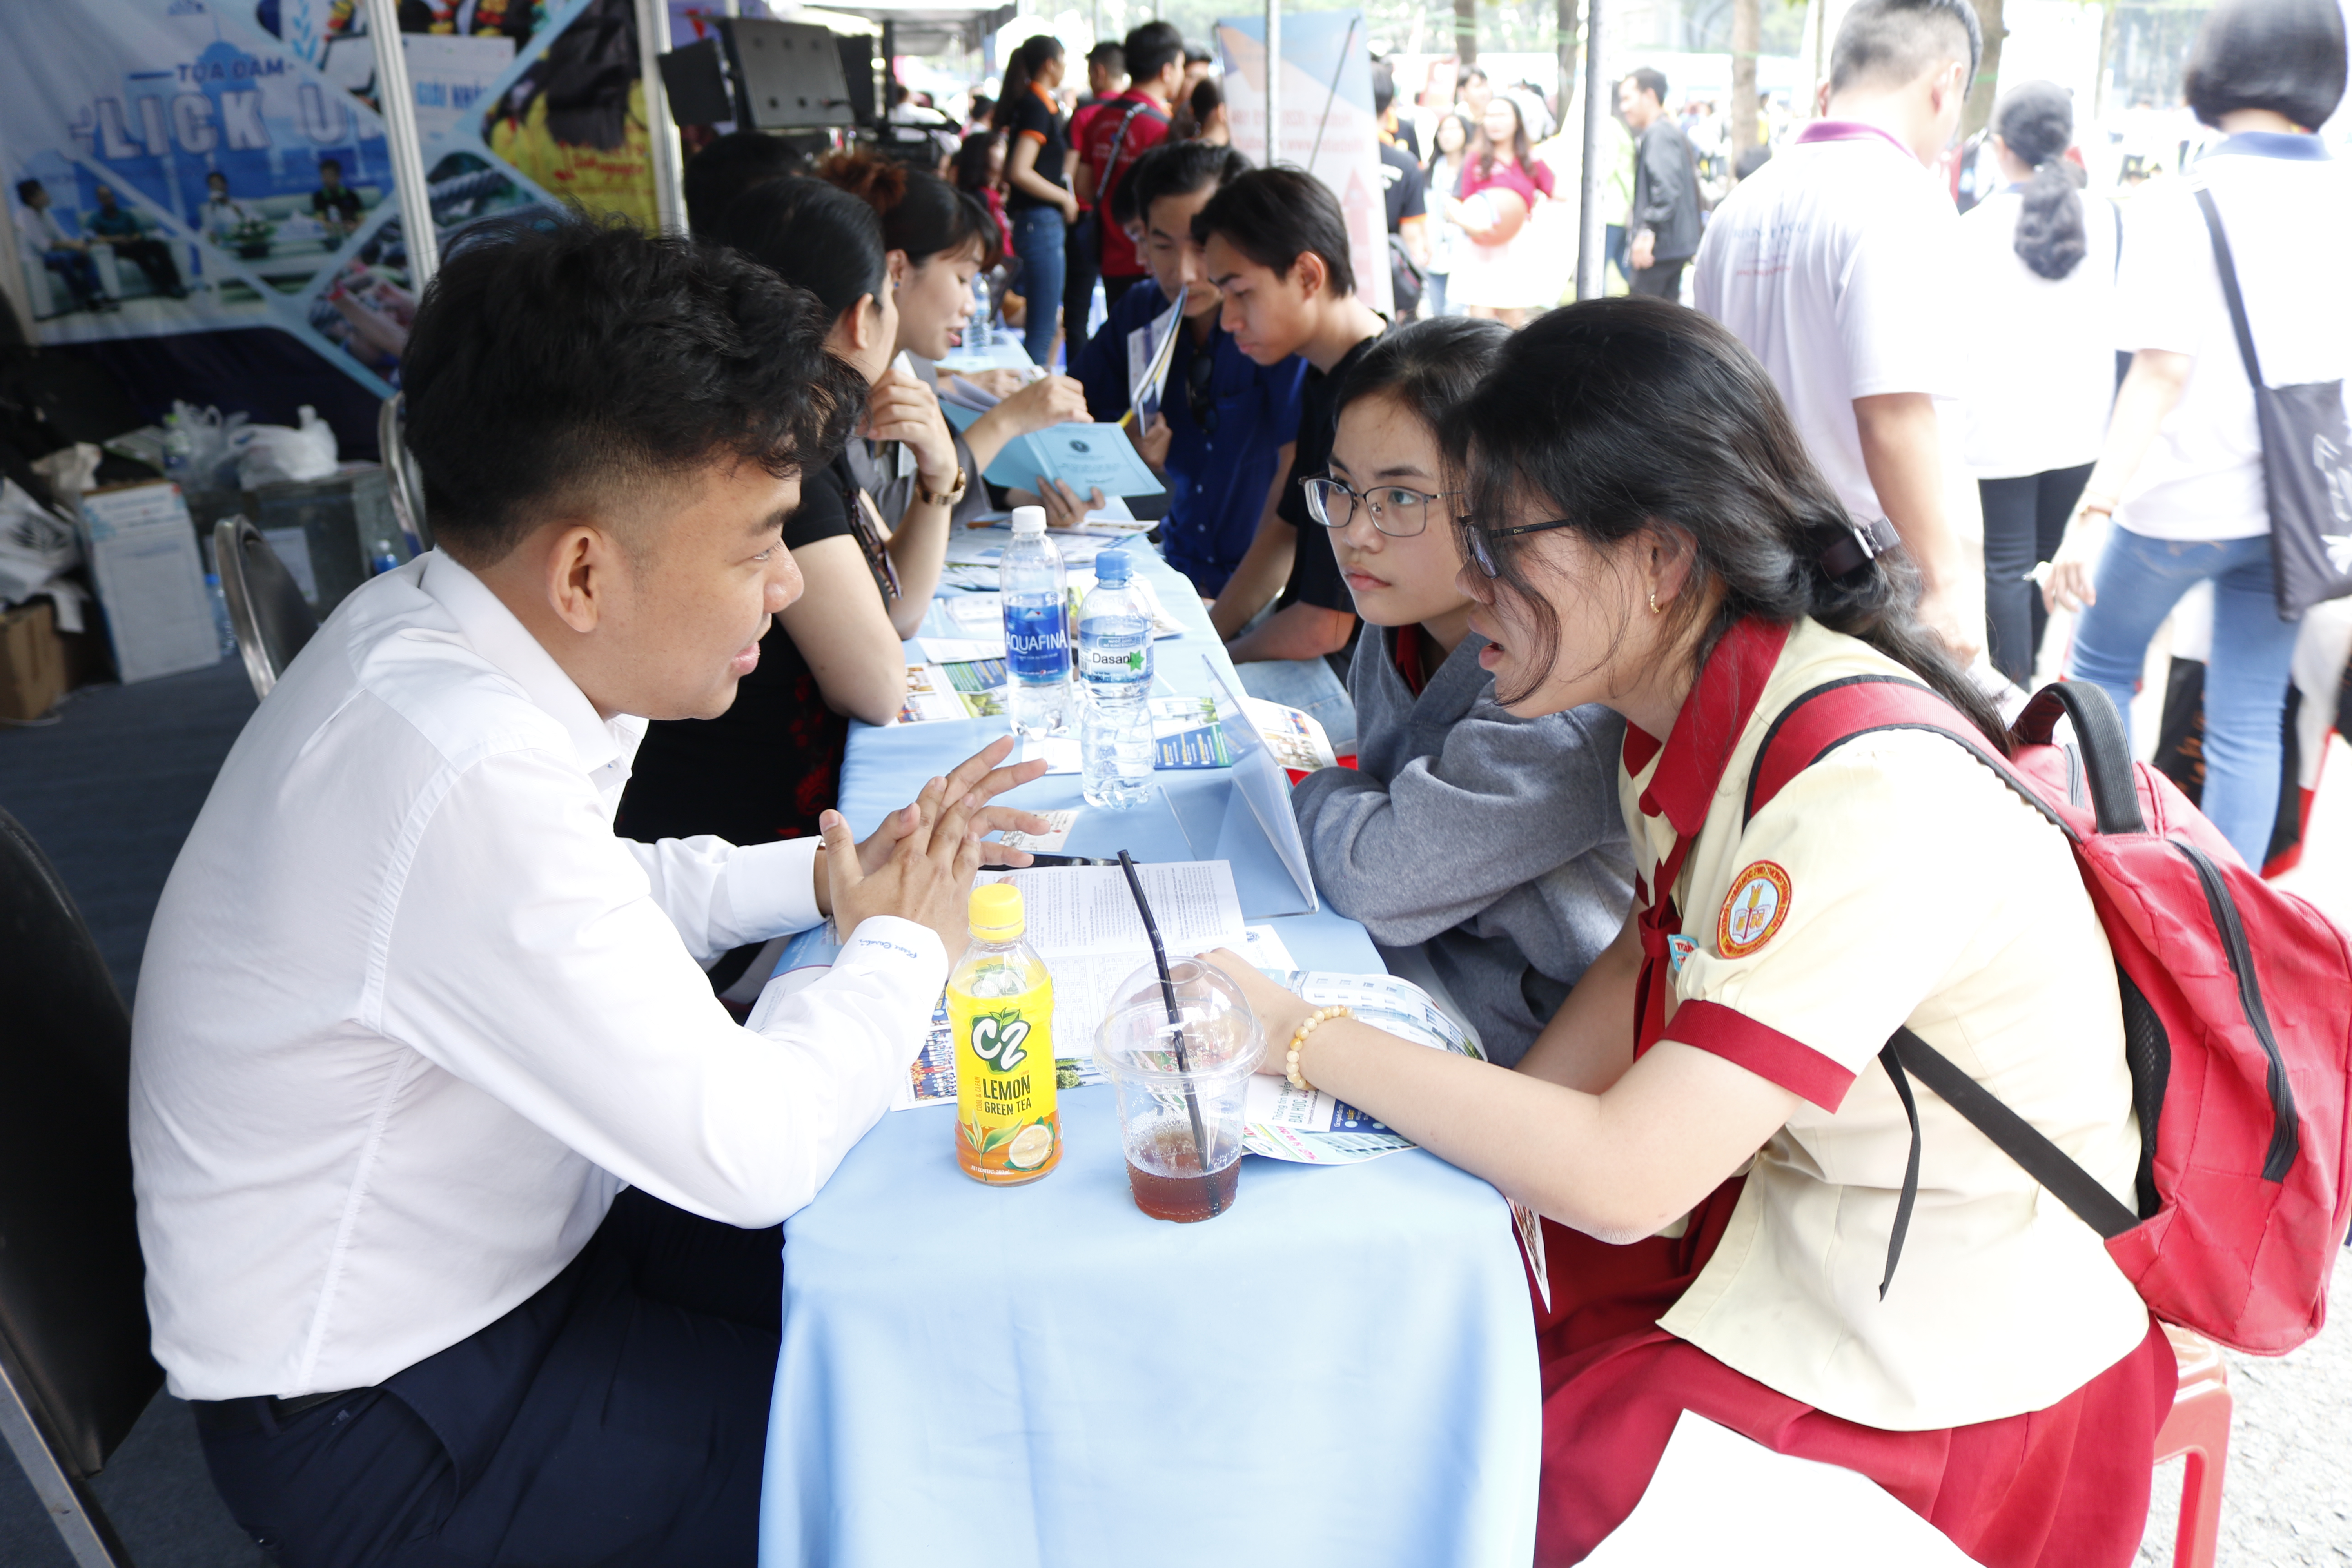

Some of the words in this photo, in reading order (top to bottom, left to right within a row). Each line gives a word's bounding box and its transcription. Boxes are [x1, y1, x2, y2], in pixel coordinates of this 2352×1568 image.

[1006, 629, 1068, 655] AQUAFINA
[858, 938, 892, 949] Cardin
[894, 945, 917, 959] Pierre
[971, 1010, 1031, 1072] C2
[982, 1074, 1031, 1101] LEMON
[1279, 1082, 1292, 1096] tuyển
[984, 1101, 1014, 1116] GREEN
[1016, 1097, 1032, 1113] TEA
[1272, 1105, 1287, 1120] Thông
[1290, 1099, 1309, 1112] HỌC
[1289, 1112, 1306, 1123] ĐẠI
